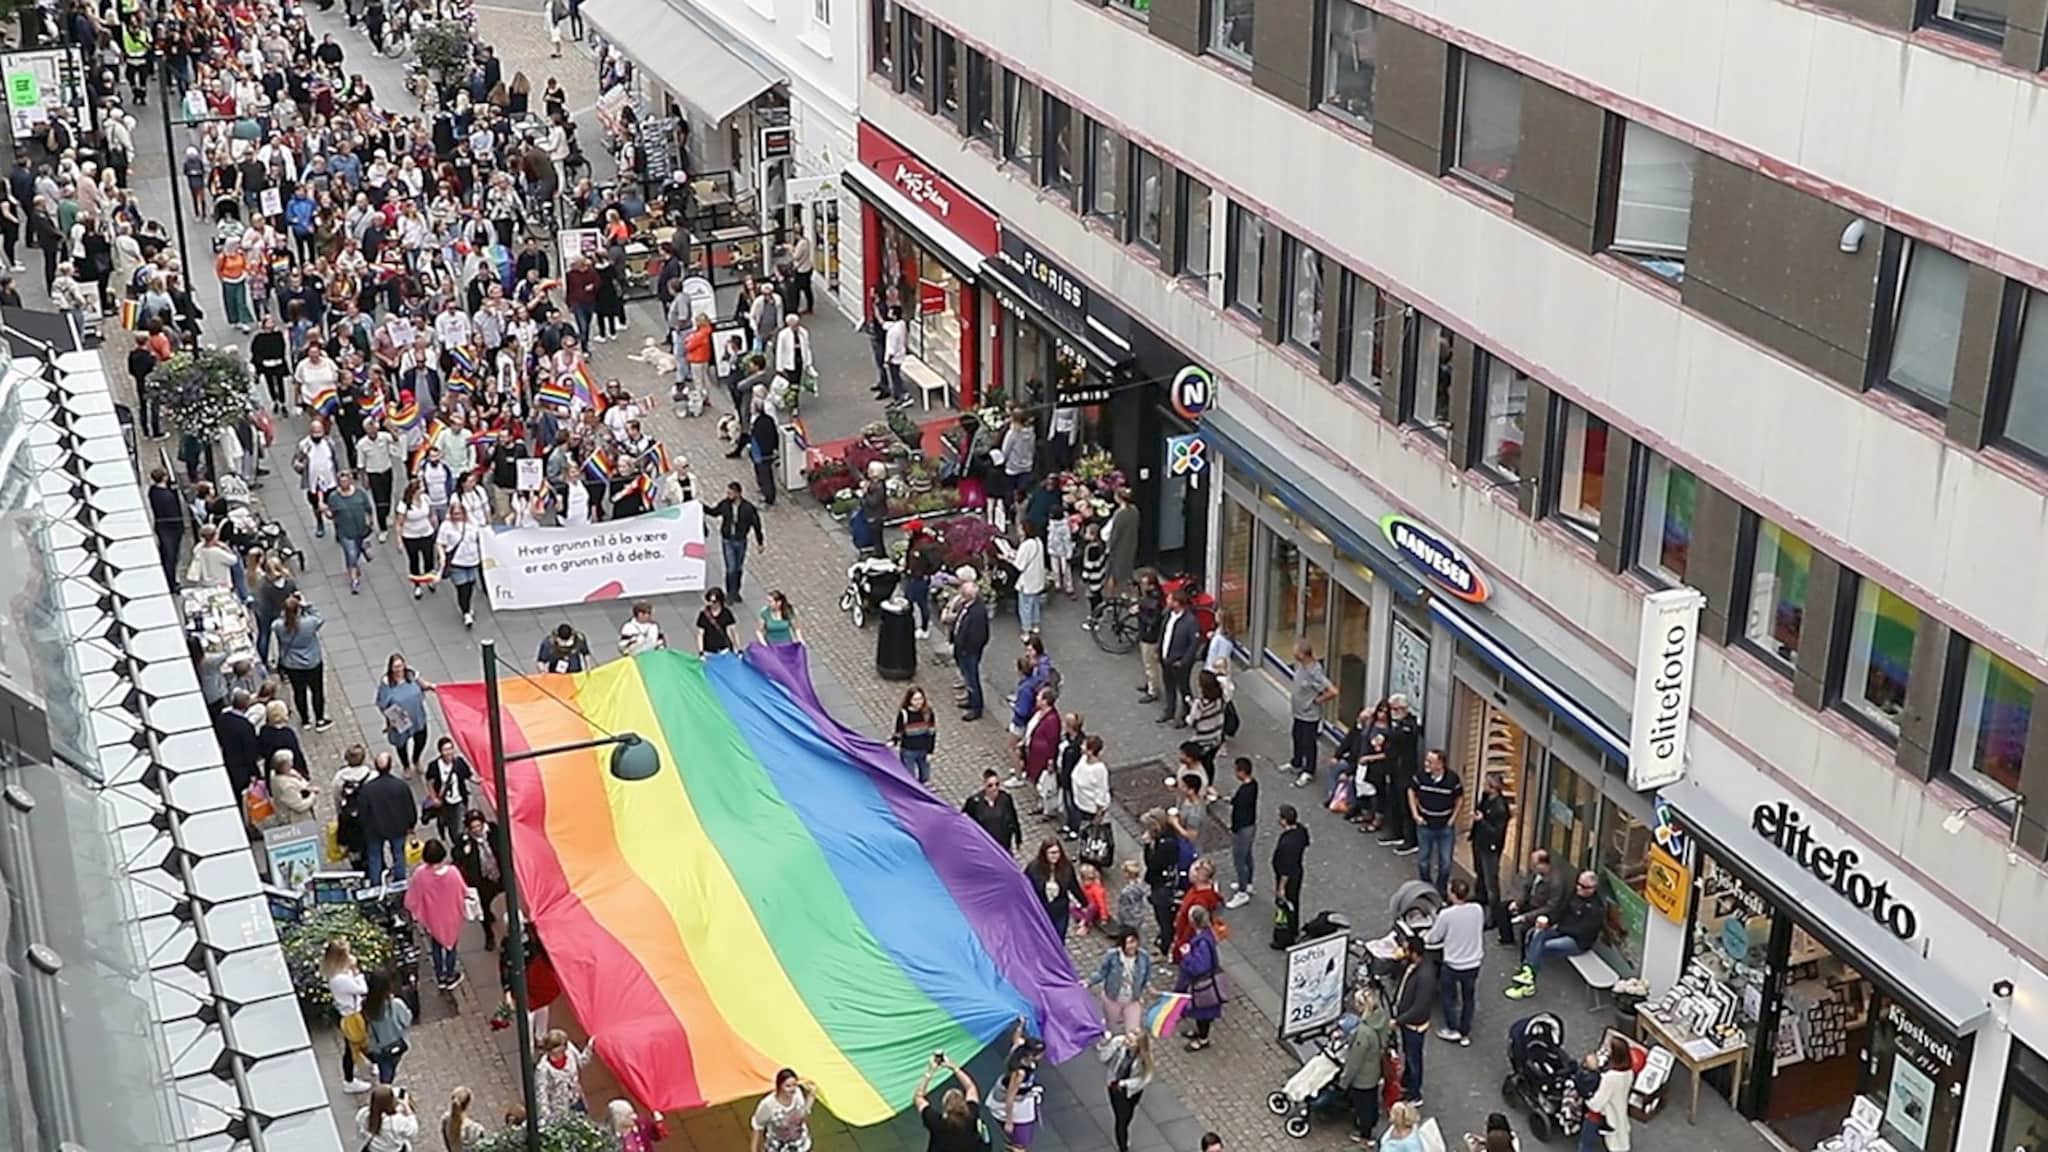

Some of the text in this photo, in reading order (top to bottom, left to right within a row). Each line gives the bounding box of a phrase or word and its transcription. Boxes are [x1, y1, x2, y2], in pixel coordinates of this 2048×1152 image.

[1024, 252, 1082, 308] FLORISS
[1183, 381, 1205, 406] N
[518, 531, 668, 558] Hver grunn til å la være
[525, 563, 539, 574] er
[542, 561, 558, 572] en
[561, 556, 599, 573] grunn
[601, 553, 614, 564] til
[617, 551, 626, 562] å
[1396, 525, 1470, 590] NARVESEN
[1650, 625, 1686, 760] elitefoto
[1752, 802, 1916, 939] elitefoto
